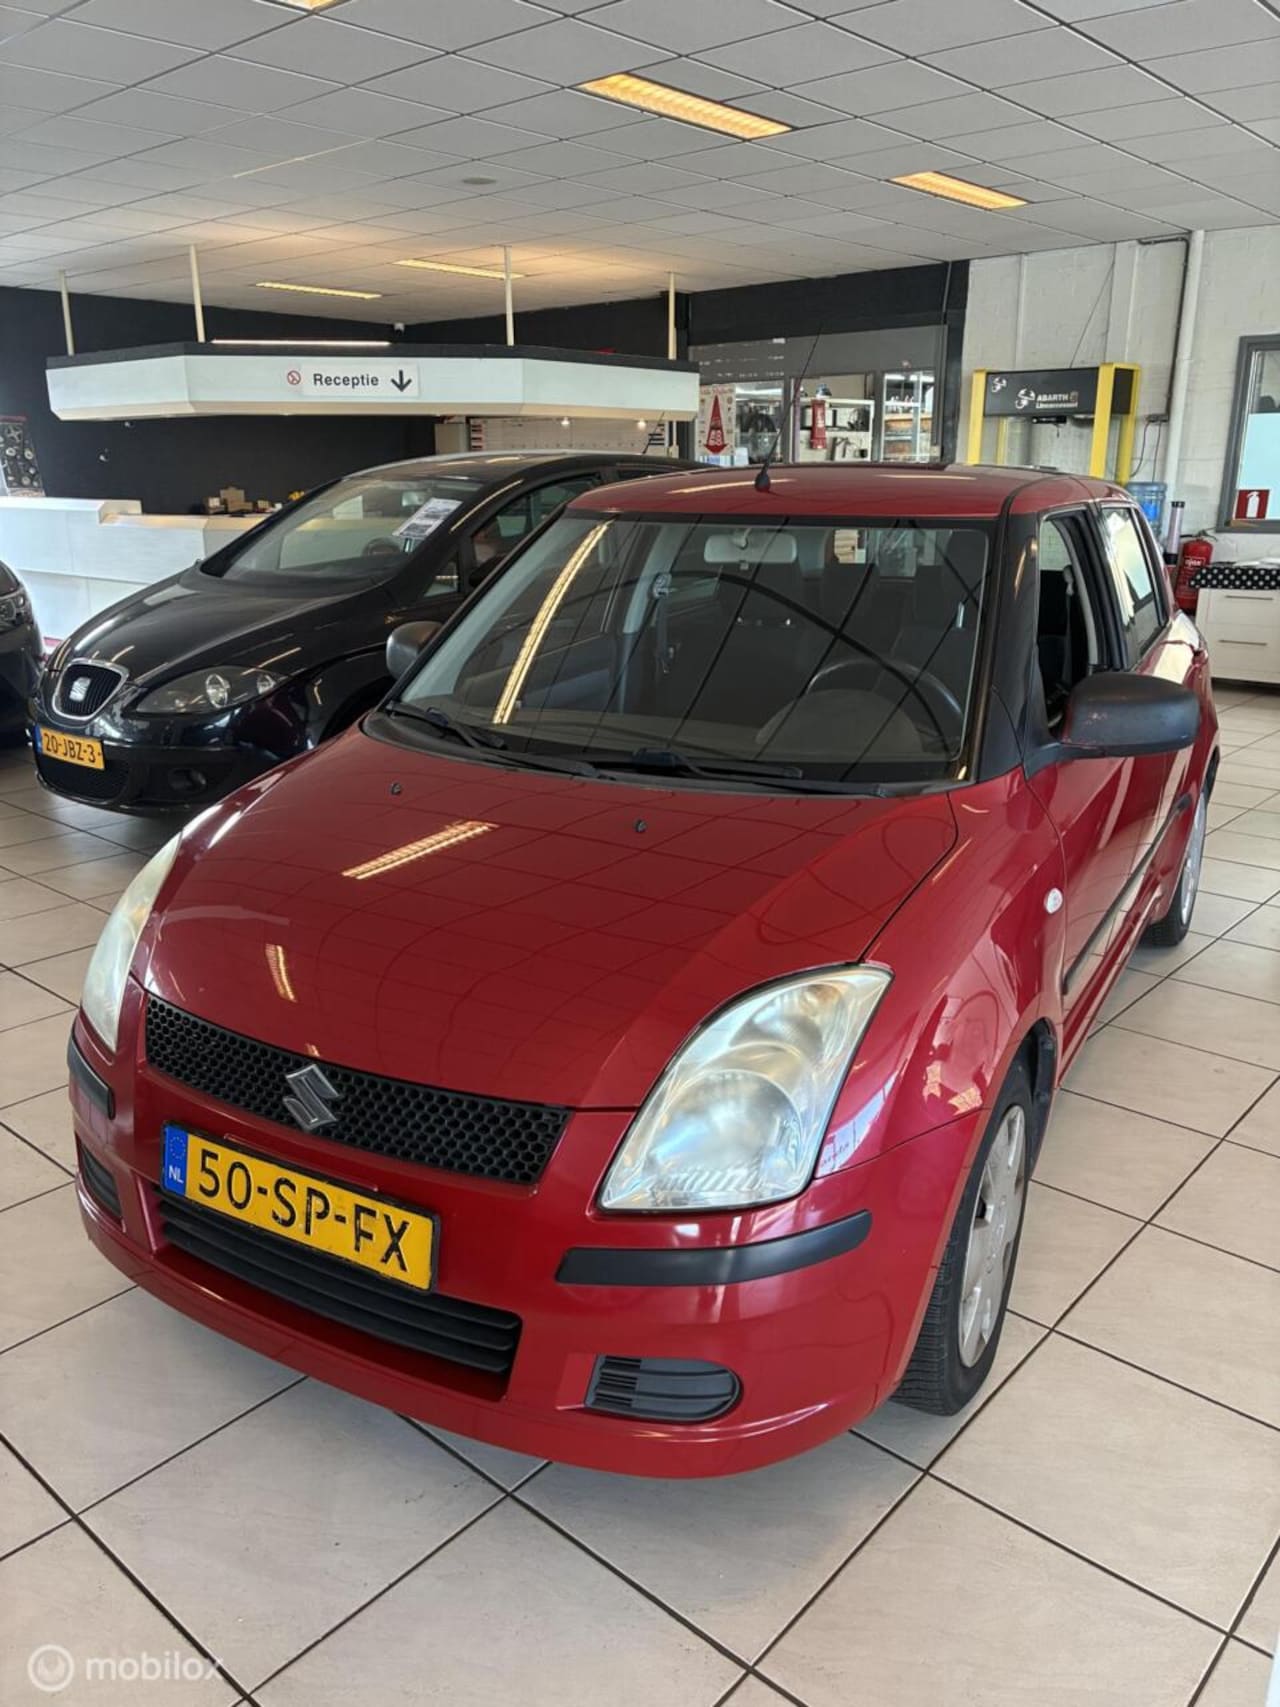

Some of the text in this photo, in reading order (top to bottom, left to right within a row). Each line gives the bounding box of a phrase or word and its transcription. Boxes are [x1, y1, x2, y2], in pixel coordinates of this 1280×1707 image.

[313, 373, 379, 389] Receptie
[1036, 393, 1069, 402] ABARTH
[43, 732, 97, 763] 20-JBZ-3
[168, 1165, 185, 1184] NL
[198, 1148, 410, 1273] 50-SP-FX
